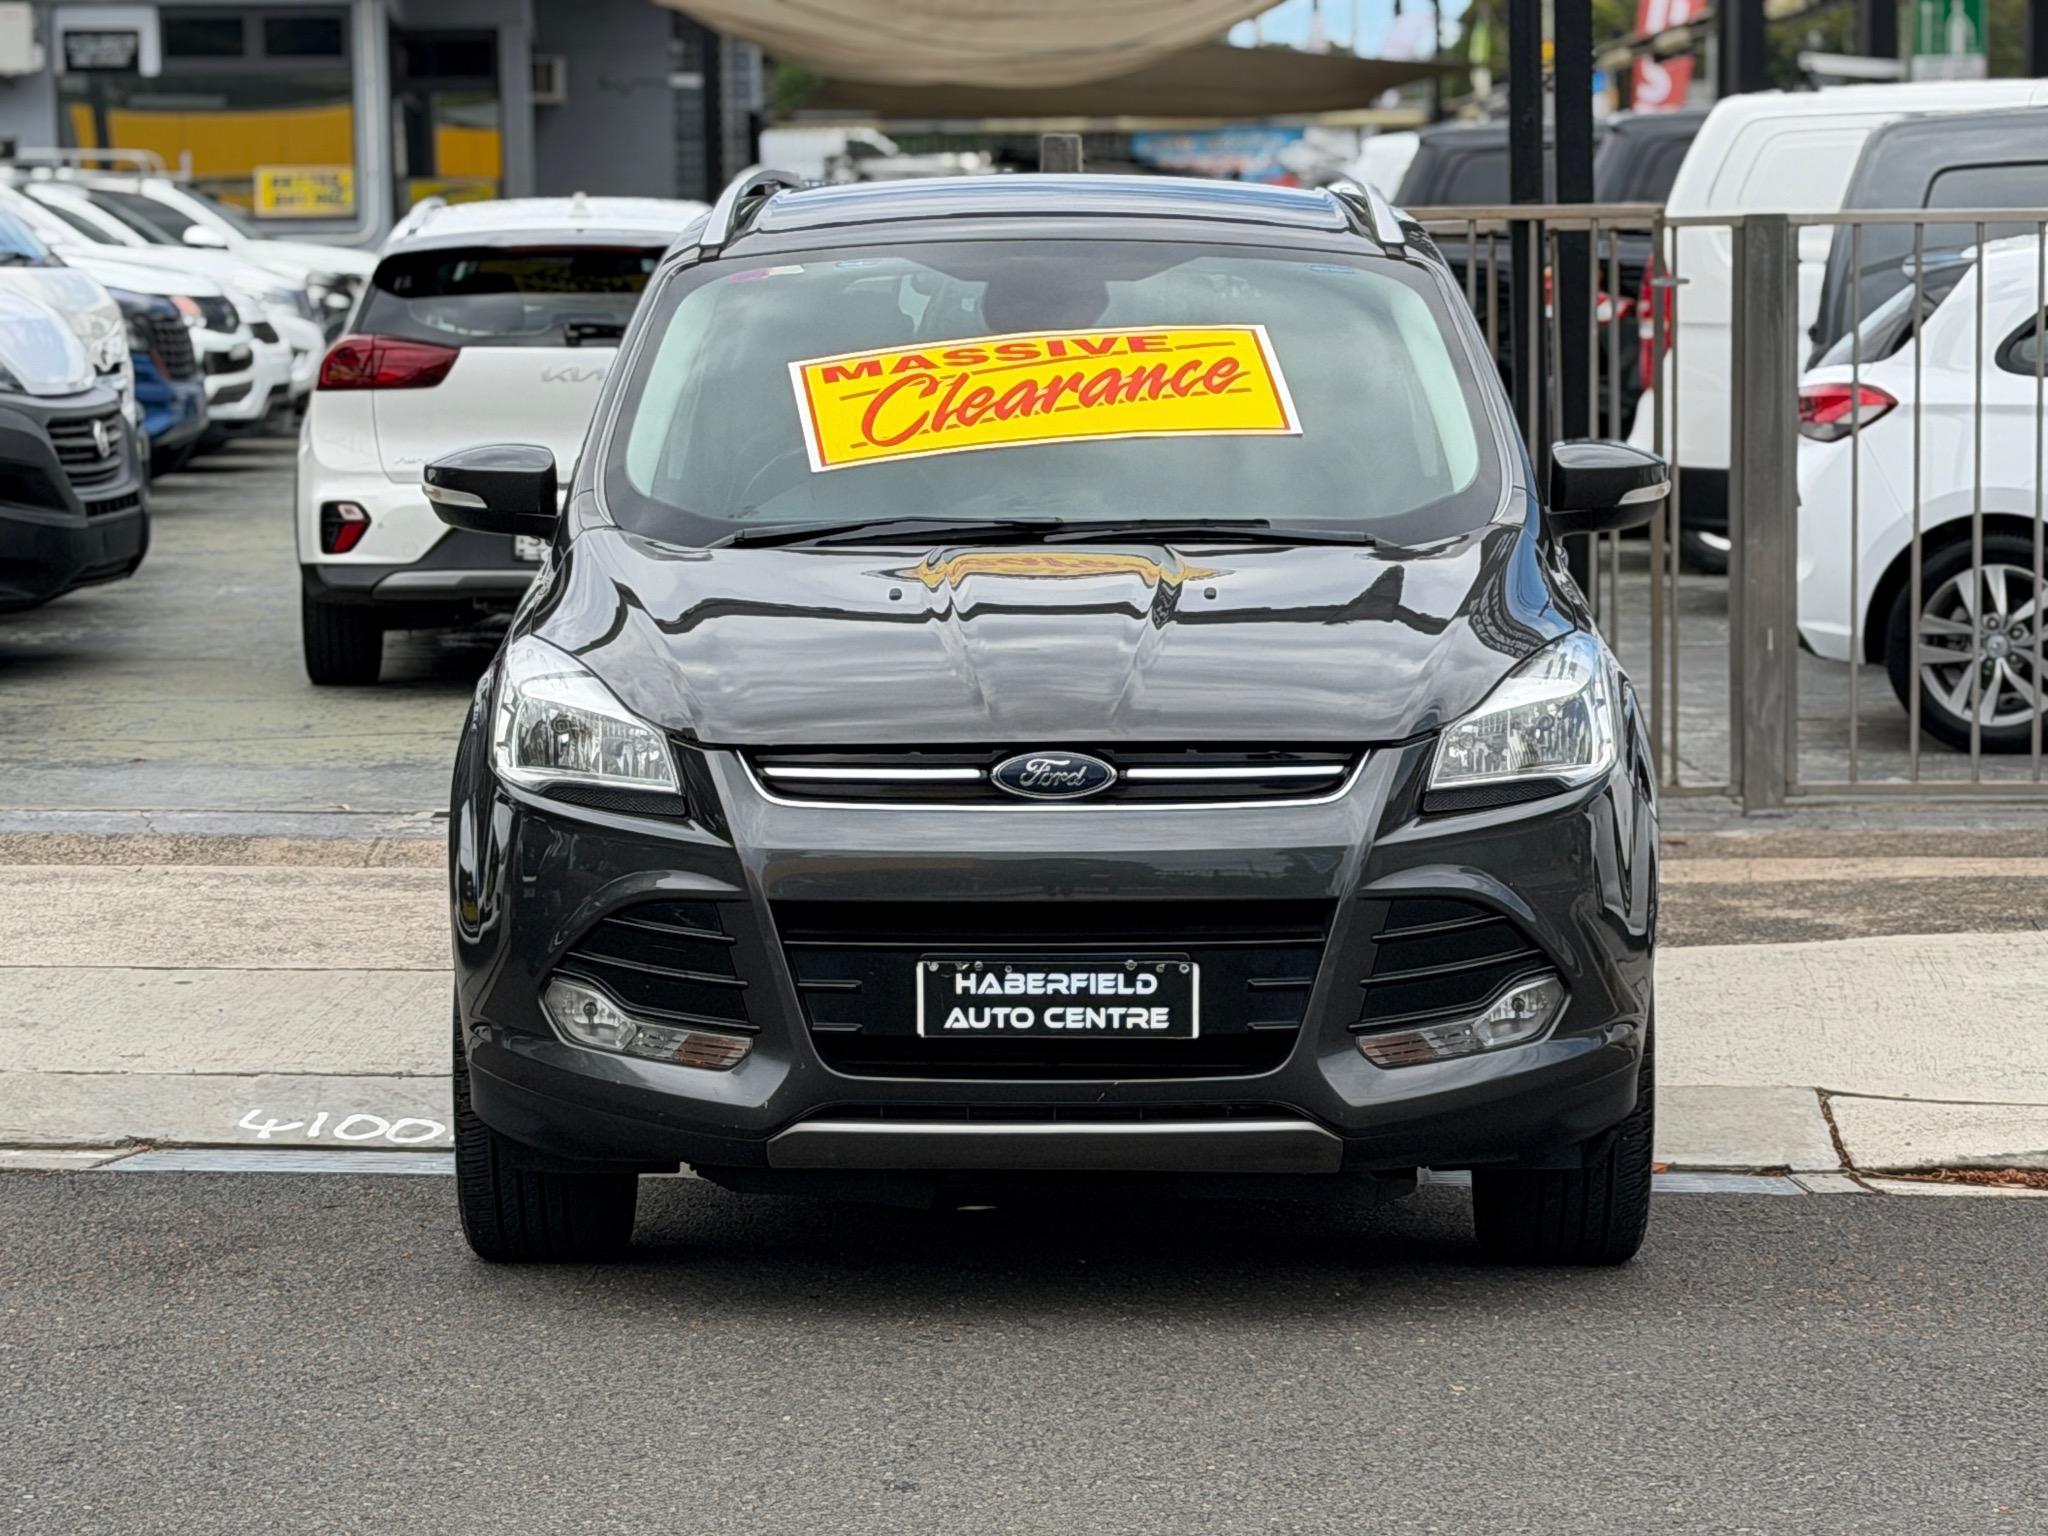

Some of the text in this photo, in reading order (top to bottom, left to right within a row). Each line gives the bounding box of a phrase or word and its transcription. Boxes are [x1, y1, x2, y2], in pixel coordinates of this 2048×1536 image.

[820, 334, 1170, 386] MASSIVE
[860, 355, 1241, 448] Clearance
[1019, 757, 1088, 788] Ford
[954, 972, 1158, 996] HABERFIELD
[943, 1006, 1171, 1030] AUTO CENTRE
[238, 1108, 447, 1144] 4100
